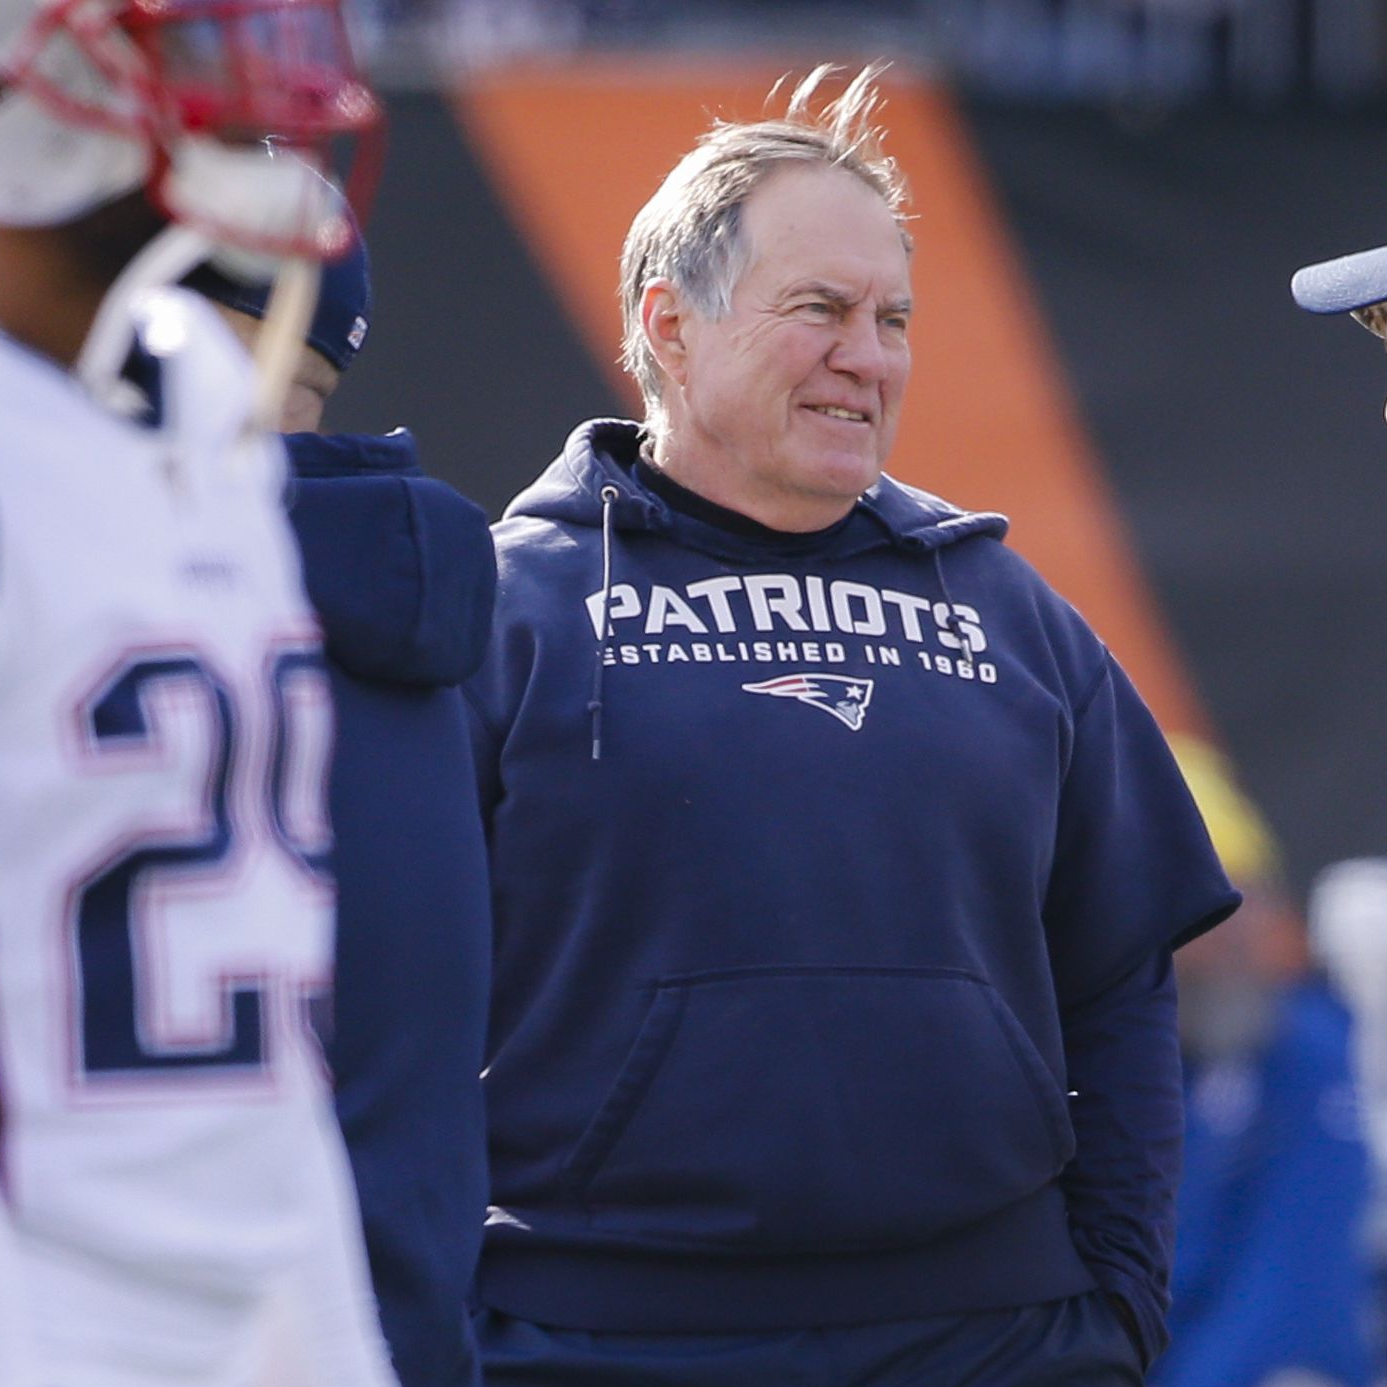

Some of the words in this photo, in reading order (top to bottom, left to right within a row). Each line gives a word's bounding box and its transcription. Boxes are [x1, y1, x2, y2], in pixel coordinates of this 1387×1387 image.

[585, 575, 988, 652] PATRIOTS
[598, 641, 846, 665] ESTABLISHED
[864, 645, 901, 666] IN
[918, 651, 997, 683] 1960
